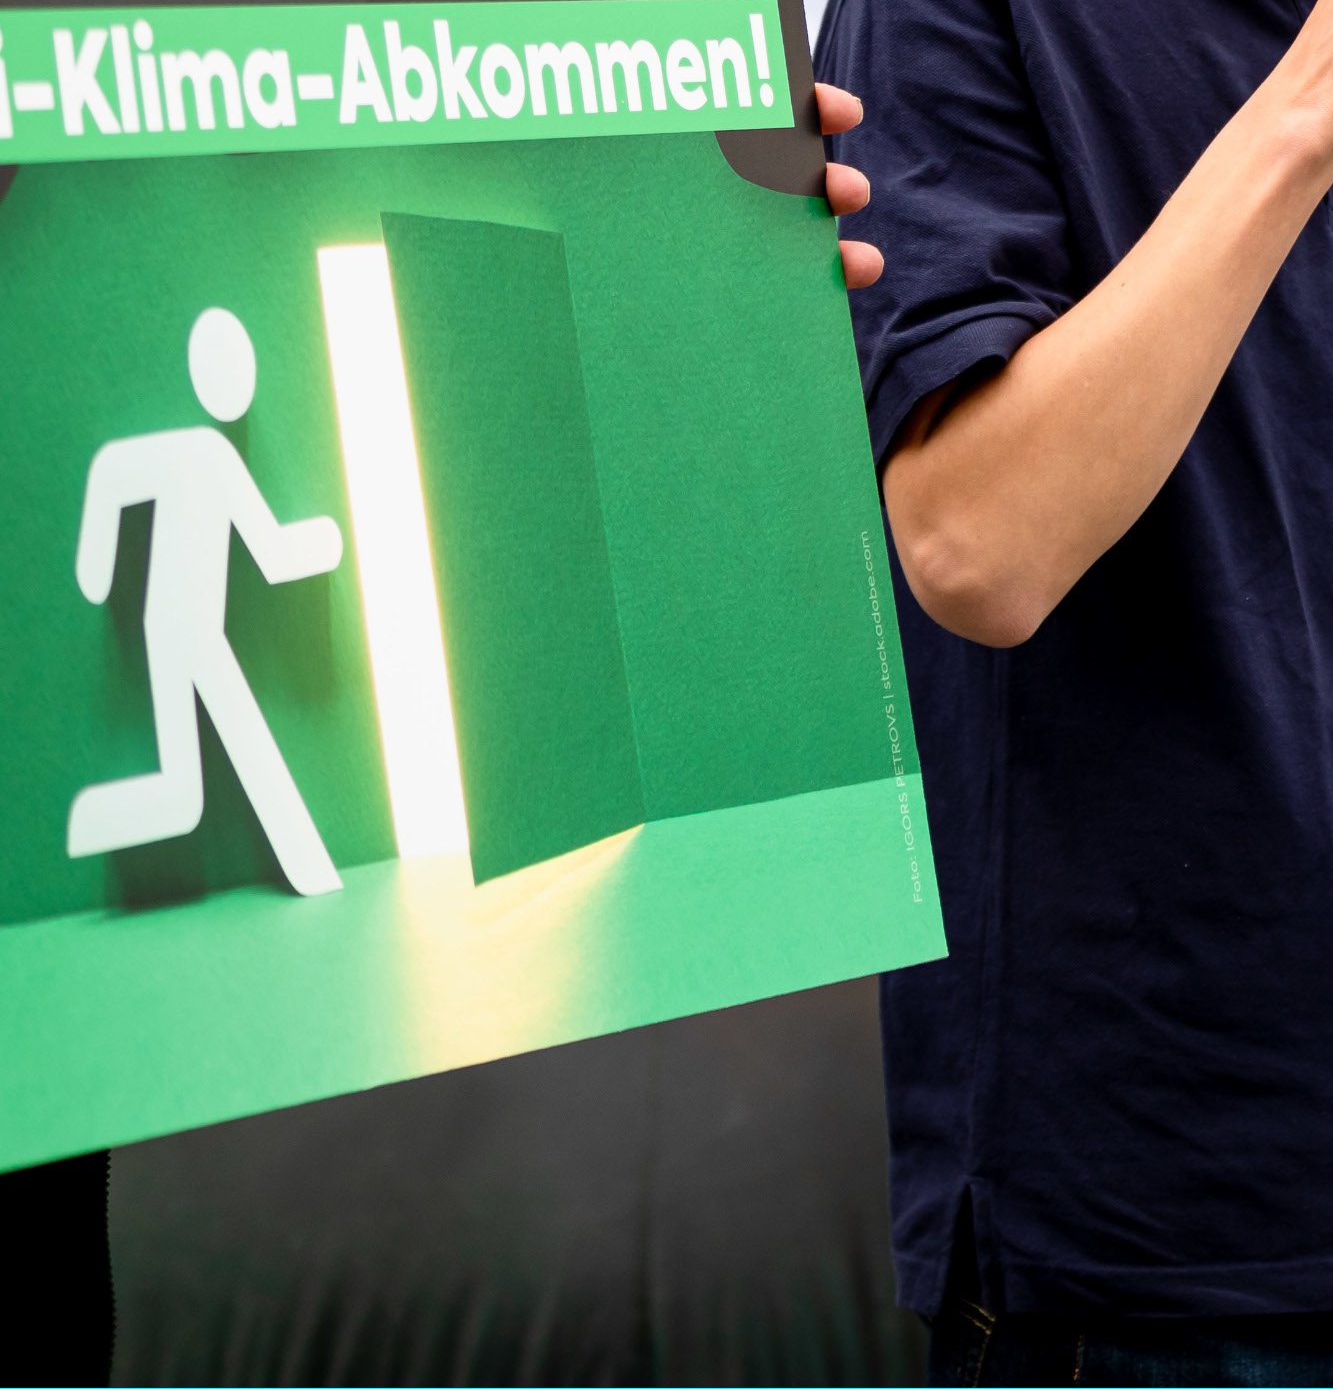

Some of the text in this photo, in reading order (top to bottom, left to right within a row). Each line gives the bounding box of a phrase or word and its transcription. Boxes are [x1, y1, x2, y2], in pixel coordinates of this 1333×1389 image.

[861, 530, 892, 691] stock.adobe.com
[885, 703, 906, 788] PETROVS
[898, 791, 915, 852] IGORS
[911, 855, 923, 903] Foto:
